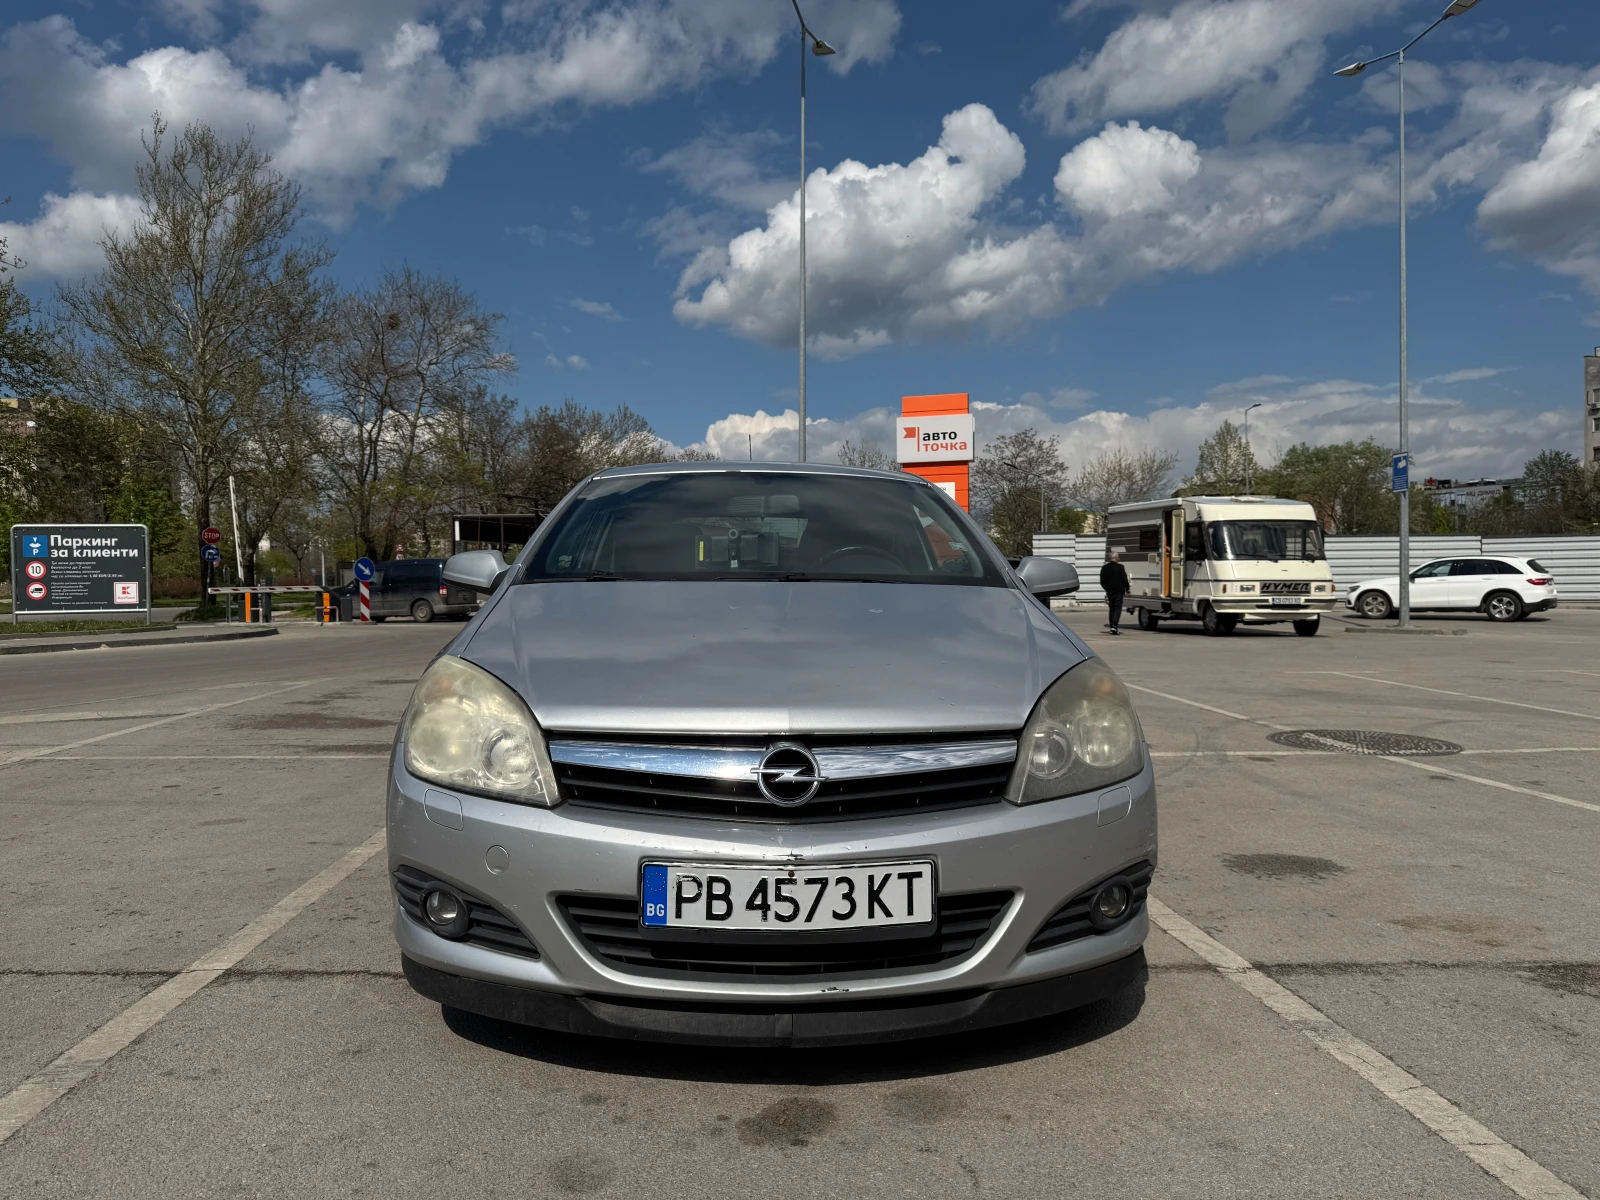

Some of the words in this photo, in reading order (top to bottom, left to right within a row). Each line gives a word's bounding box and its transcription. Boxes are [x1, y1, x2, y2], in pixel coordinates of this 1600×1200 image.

[922, 431, 957, 441] авто
[922, 441, 967, 452] точка
[204, 532, 220, 540] STOP
[50, 535, 118, 549] Паркинг
[50, 549, 68, 558] за
[73, 548, 138, 558] клиенти
[31, 565, 41, 574] 10
[1261, 582, 1310, 591] HYMER
[675, 873, 733, 921] PB
[745, 876, 857, 922] 4573
[867, 871, 923, 919] KT
[646, 903, 665, 917] BG
